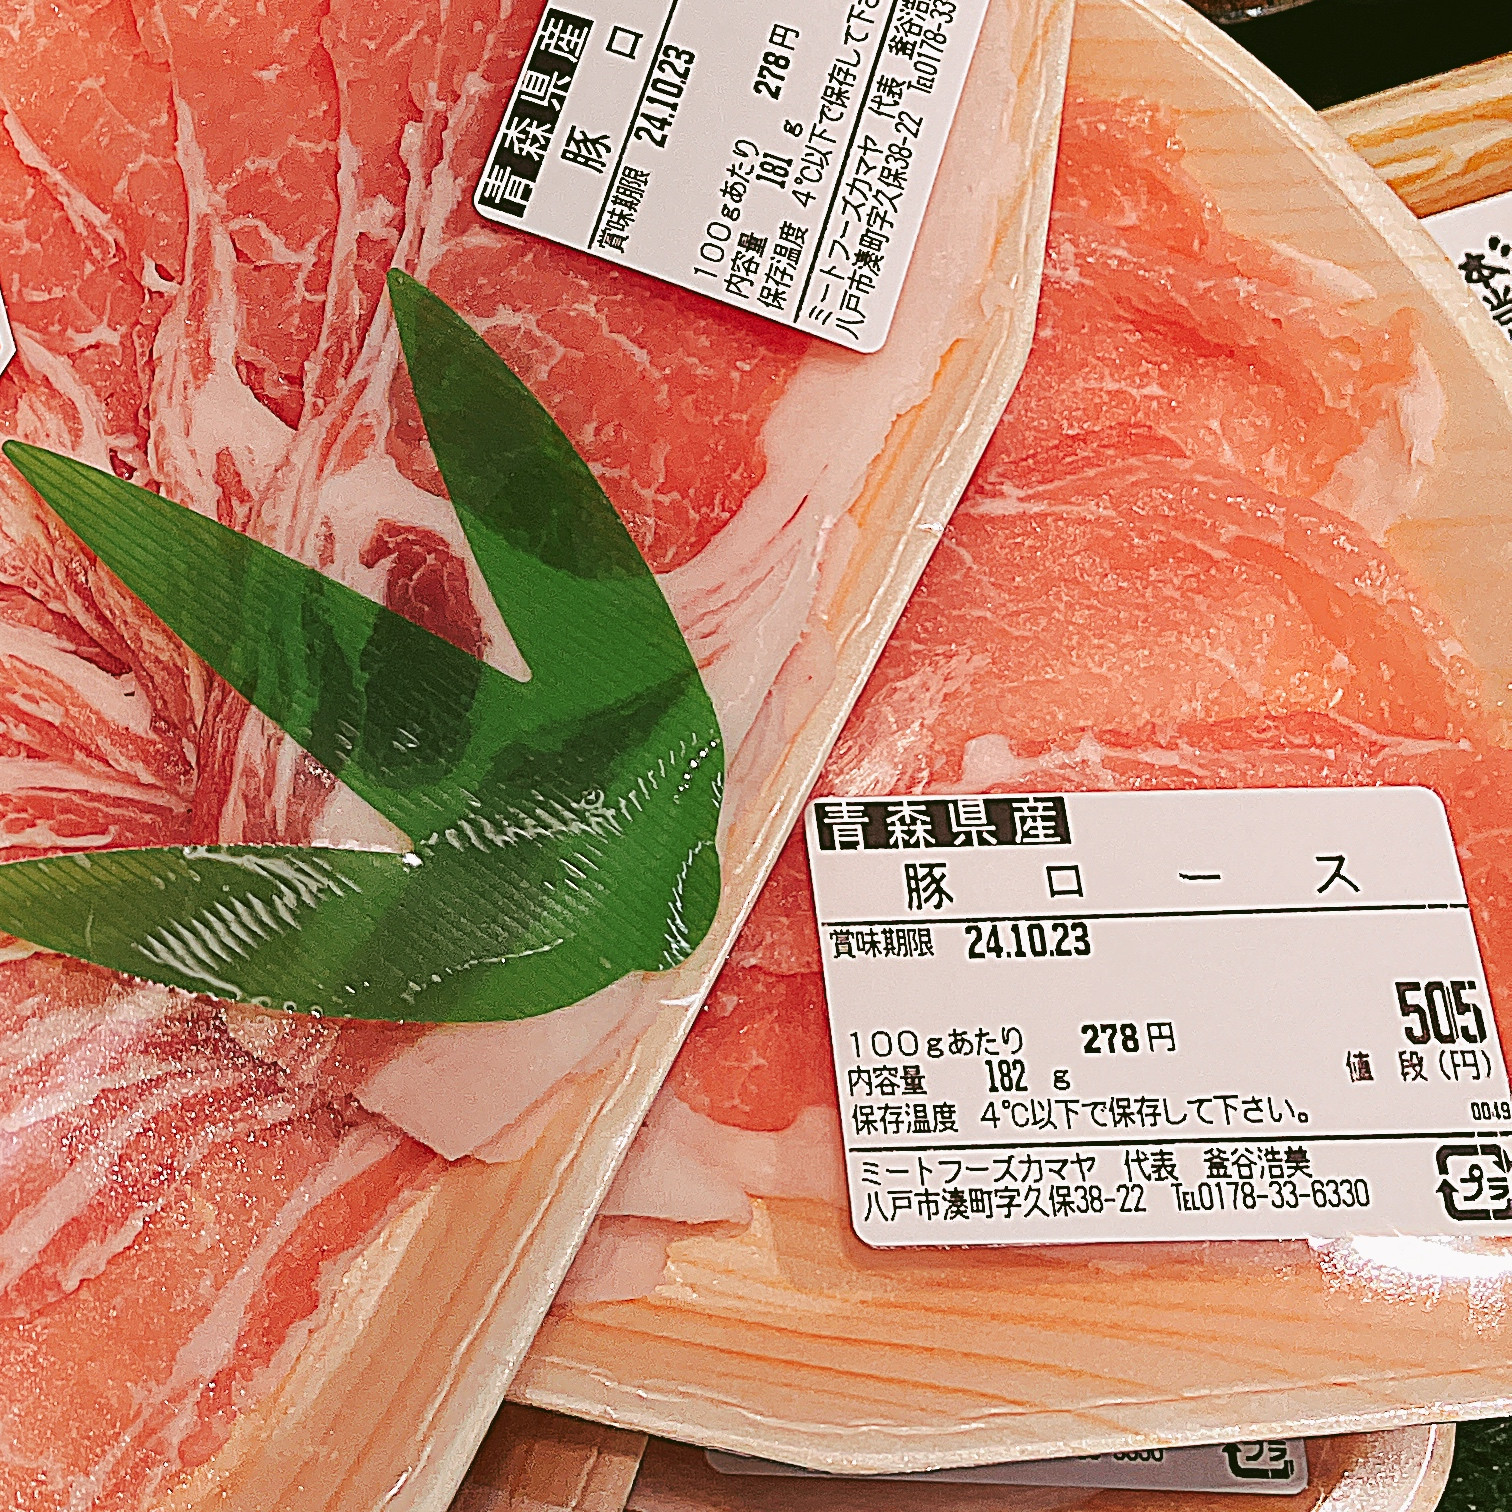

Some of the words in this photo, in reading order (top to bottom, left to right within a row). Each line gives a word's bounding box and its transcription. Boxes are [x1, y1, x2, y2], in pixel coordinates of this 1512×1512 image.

[481, 8, 593, 217] 青森県産
[597, 166, 650, 253] 賞味期限
[634, 45, 695, 148] 24.10.23
[694, 140, 759, 277] 100gあたり
[724, 232, 768, 299] 内容量
[756, 152, 793, 189] 181
[809, 135, 883, 325] ミートフーズカマヤ
[870, 75, 906, 119] 代表
[757, 221, 808, 310] 保存温度
[820, 797, 1069, 849] 青森県産
[830, 928, 934, 958] 賞味期限
[962, 921, 1090, 959] 24.10.23
[850, 1027, 1022, 1060] 100gあたり
[1395, 980, 1487, 1044] 505
[848, 1065, 927, 1096] 内容量
[985, 1059, 1028, 1092] 182
[852, 1102, 958, 1135] 保存温度
[862, 1153, 1095, 1186] ミートフーズカマヤ
[1124, 1149, 1178, 1182] 代表
